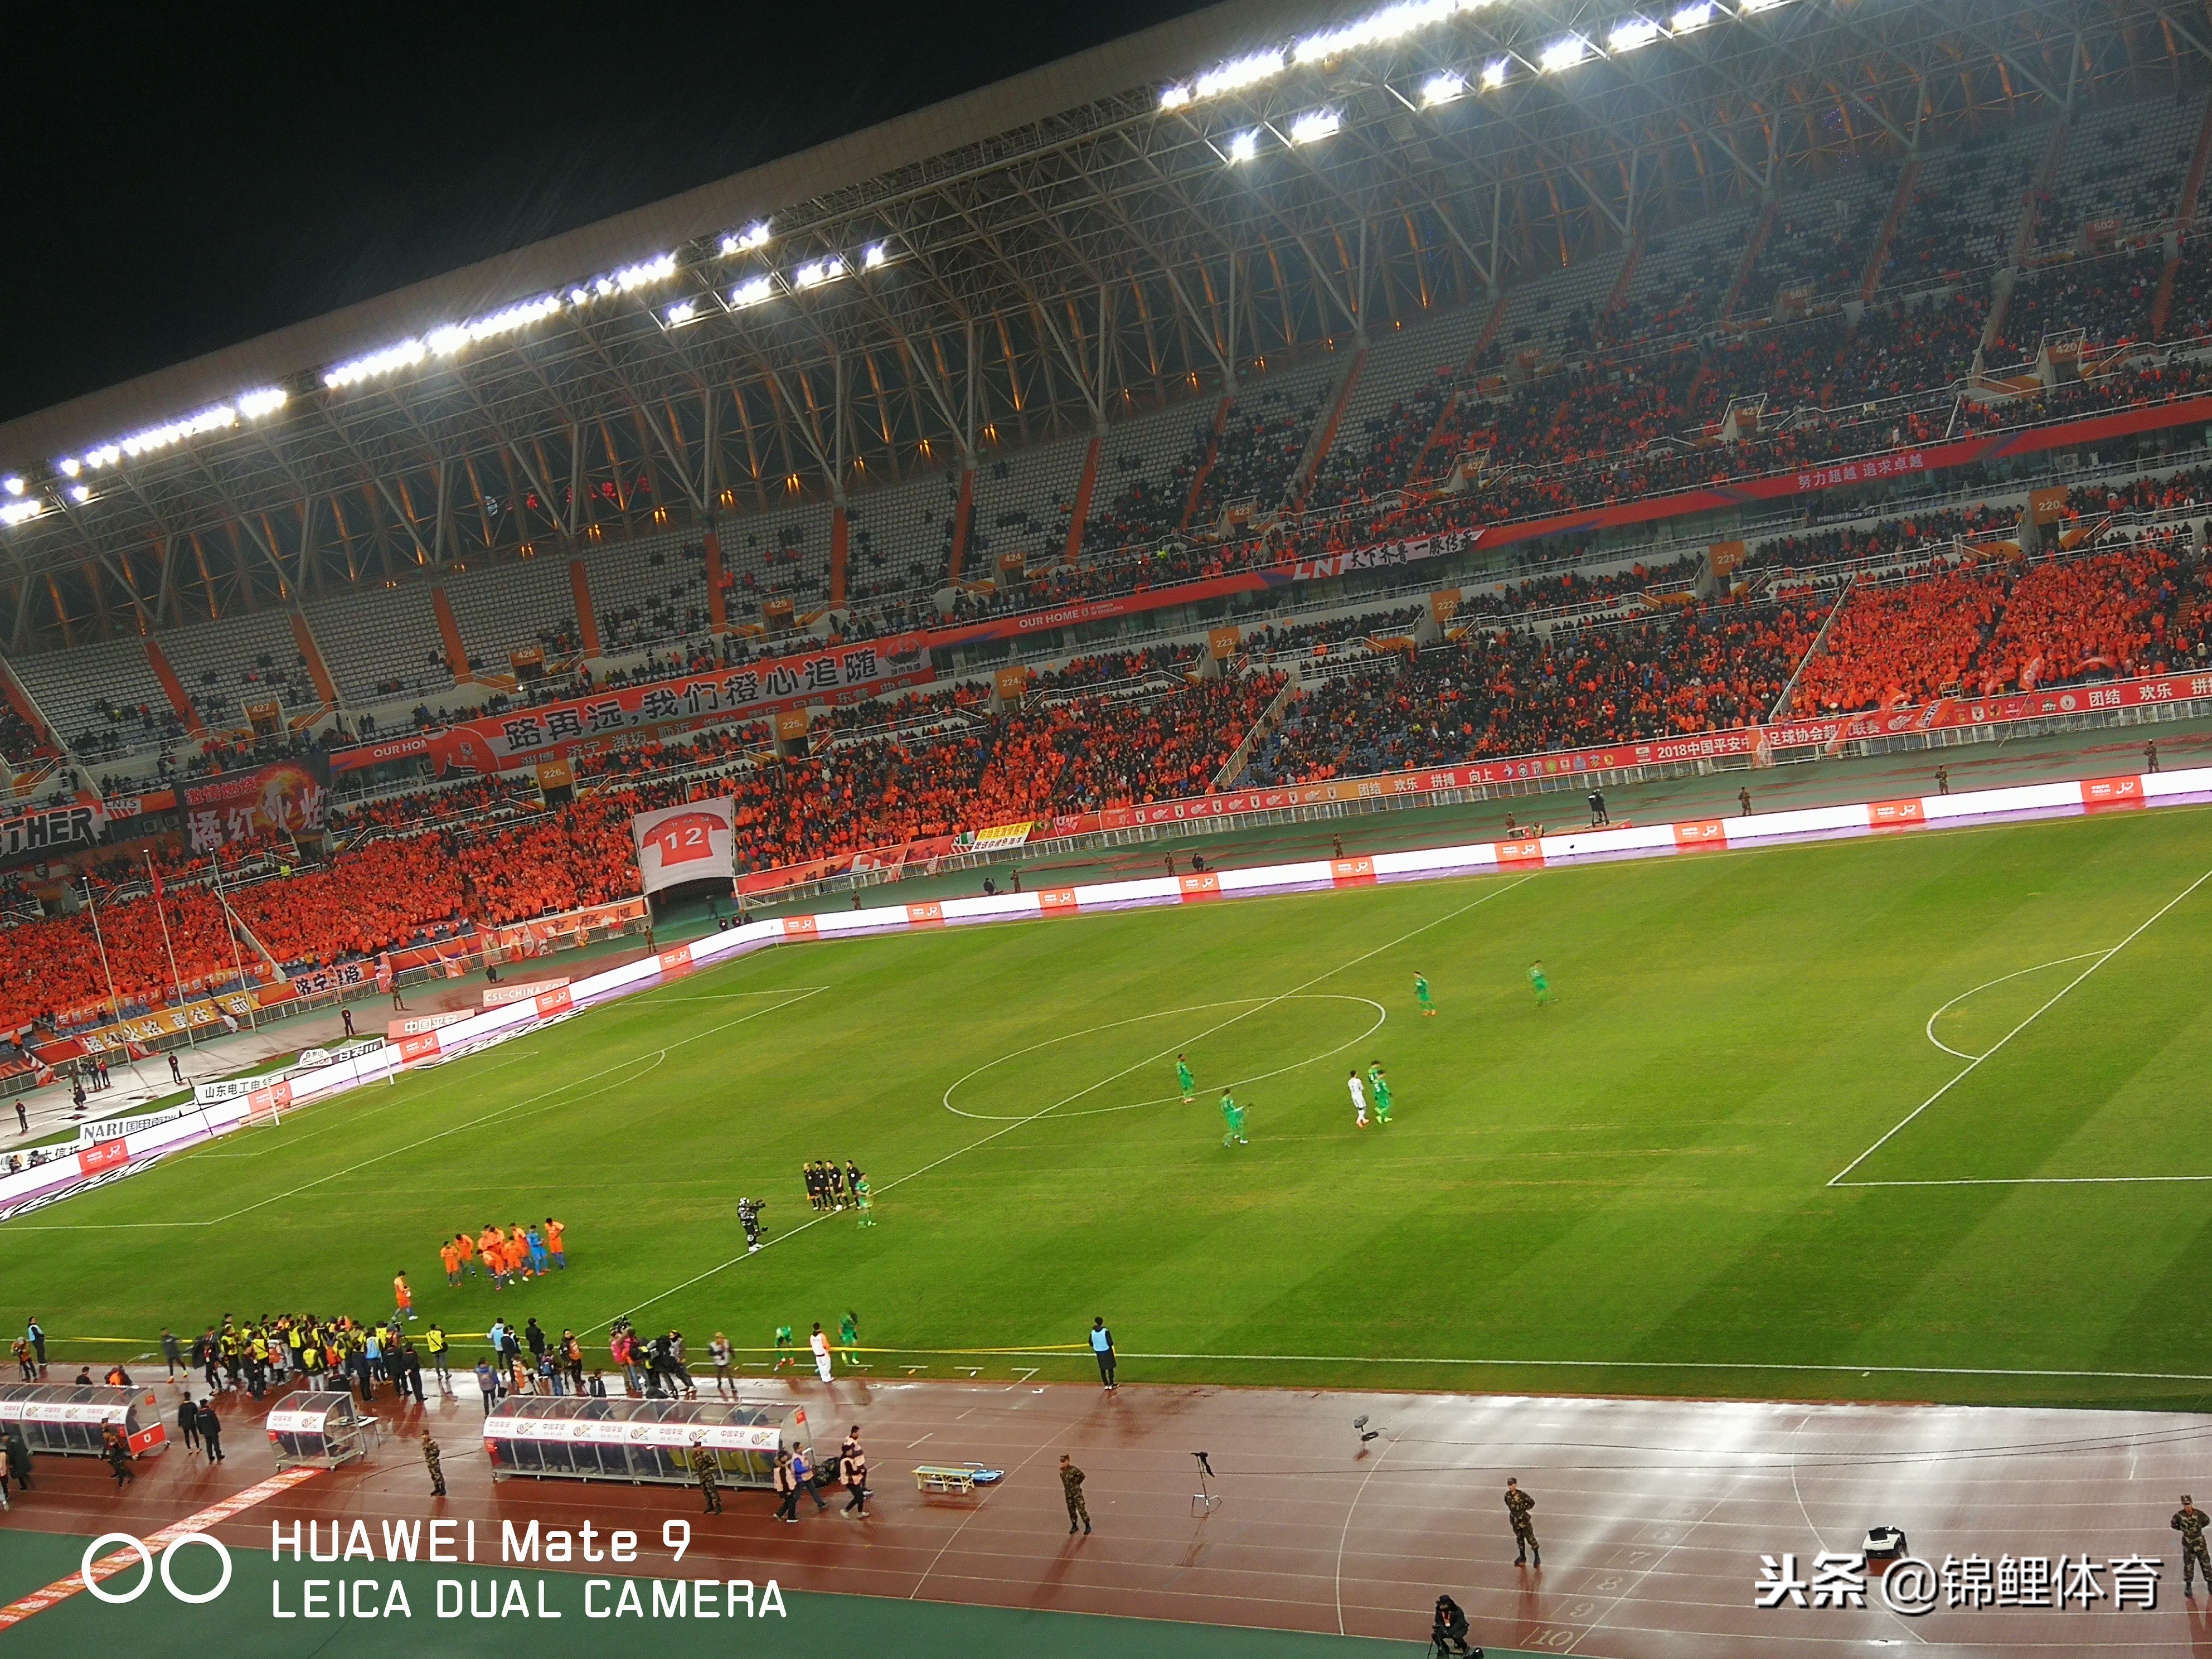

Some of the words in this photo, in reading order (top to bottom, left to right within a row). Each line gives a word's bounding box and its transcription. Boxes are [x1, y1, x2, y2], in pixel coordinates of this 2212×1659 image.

[1798, 465, 1857, 489] 努力超越
[1863, 453, 1923, 477] 追求卓越
[1350, 540, 1409, 568] 天下齐鲁
[1019, 617, 1043, 628] OUR
[1045, 610, 1079, 623] HOME
[2088, 688, 2121, 709] 团结
[2139, 682, 2173, 700] 欢乐
[2191, 677, 2212, 695] 拼
[373, 743, 400, 758] OUR
[566, 740, 601, 758] 济宁
[612, 729, 647, 749] 潍坊
[184, 775, 258, 806] 激情燃烧
[1357, 781, 1382, 797] 团结
[1394, 777, 1419, 792] 欢乐
[1430, 772, 1456, 788] 拼搏
[1468, 768, 1494, 783] 向上
[0, 806, 100, 857] THER
[665, 827, 704, 850] 12
[171, 996, 250, 1029] 勇往前
[404, 1013, 458, 1034] 中国平安
[84, 1122, 124, 1140] NARI
[1597, 1576, 1623, 1590] 8
[1531, 1630, 1574, 1646] 10
